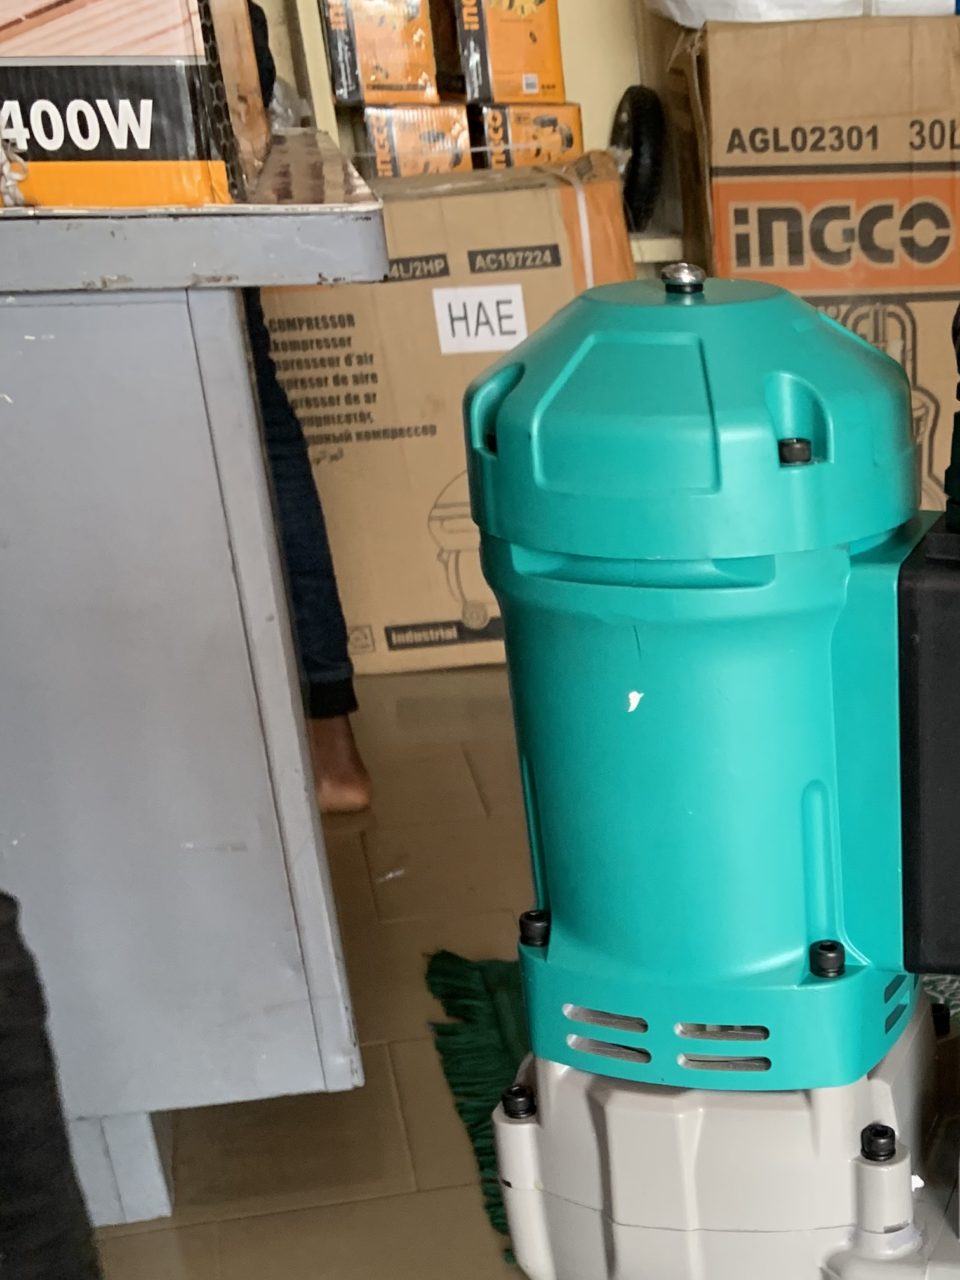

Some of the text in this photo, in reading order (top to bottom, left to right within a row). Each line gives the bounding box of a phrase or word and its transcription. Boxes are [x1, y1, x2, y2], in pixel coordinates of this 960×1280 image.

[0, 98, 153, 151] 400W
[726, 124, 880, 155] AGL02301
[733, 203, 952, 268] INGCO
[475, 249, 552, 271] AC197224
[448, 299, 517, 338] HAE
